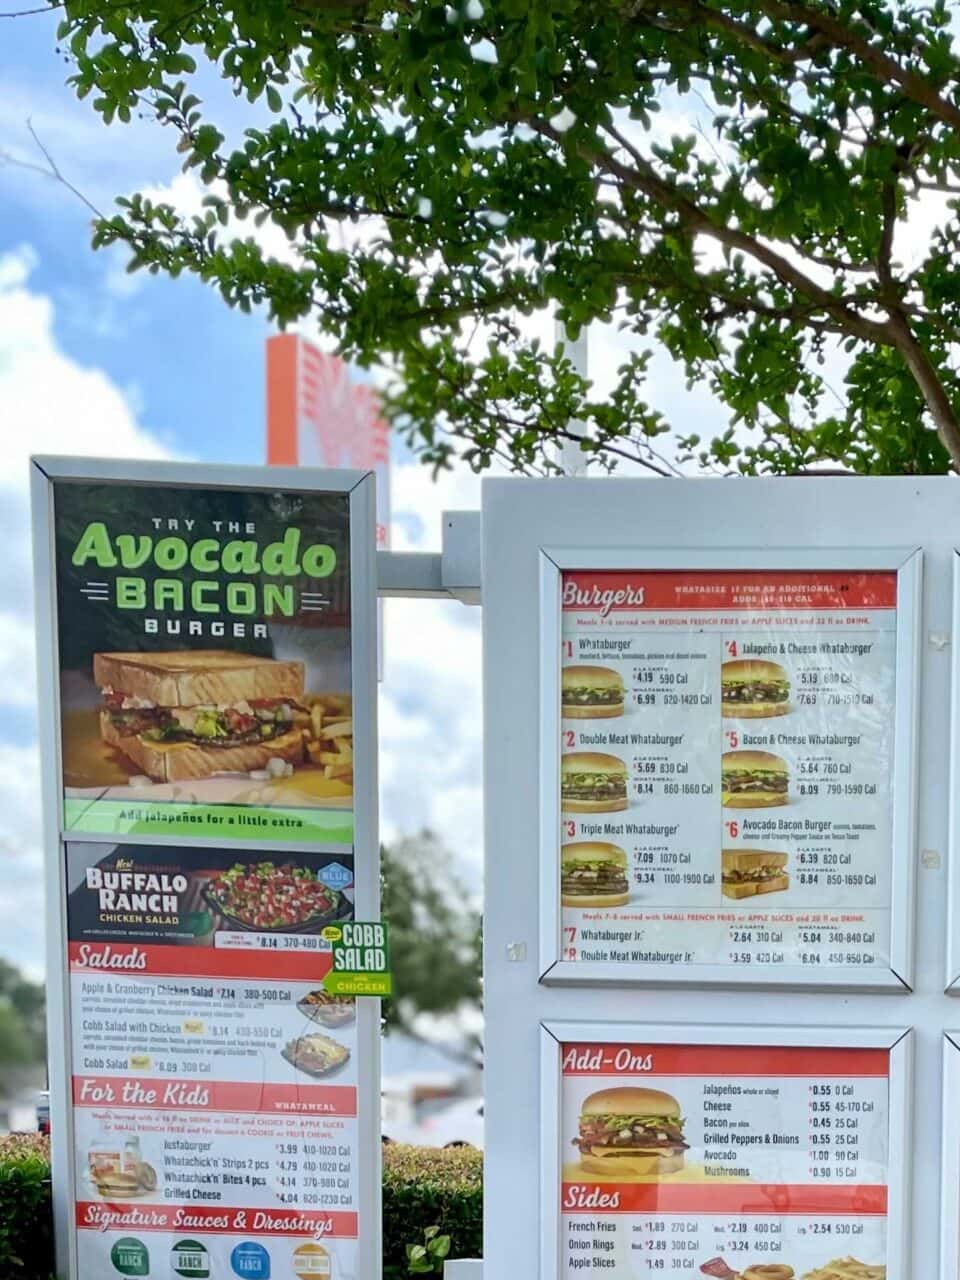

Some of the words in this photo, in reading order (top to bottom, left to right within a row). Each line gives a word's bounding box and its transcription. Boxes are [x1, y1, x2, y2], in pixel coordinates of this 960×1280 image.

[152, 518, 195, 530] TRY
[213, 521, 256, 533] THE
[72, 522, 337, 577] Avocado
[116, 577, 294, 616] BACON
[562, 582, 644, 617] Burgers
[145, 619, 268, 638] BURGER
[580, 733, 606, 744] Double
[609, 734, 629, 745] Meat
[743, 734, 767, 745] Bacon
[778, 734, 806, 744] Cheese
[238, 814, 268, 826] little
[743, 820, 774, 831] Avocado
[777, 820, 802, 831] Bacon
[805, 820, 831, 832] Burger
[580, 824, 601, 835] Triple
[604, 824, 624, 834] Meat
[86, 867, 188, 893] BUFFALO
[99, 893, 177, 913] RANCH
[100, 913, 142, 923] CHICKEN
[146, 915, 179, 925] SALAD
[343, 925, 384, 946] COBB
[76, 945, 147, 969] Salads
[335, 948, 386, 970] SALAD
[192, 986, 213, 997] Salad
[337, 982, 386, 992] CHICKEN
[104, 1021, 127, 1031] Salad
[563, 1049, 652, 1072] Add-Ons
[81, 1080, 115, 1101] For
[122, 1083, 156, 1103] the
[164, 1084, 209, 1106] Kids
[704, 1084, 742, 1096] Jalapeños
[704, 1101, 732, 1112] Cheese
[704, 1117, 728, 1128] Bacon
[704, 1133, 729, 1144] Grilled
[731, 1134, 763, 1145] Peppers
[773, 1134, 799, 1144] Onions
[704, 1150, 737, 1161] Avocado
[704, 1166, 750, 1177] Mushrooms
[192, 1190, 221, 1200] Cheese
[564, 1186, 620, 1208] Sides
[84, 1205, 167, 1231] Signature
[173, 1206, 228, 1229] Sauces
[253, 1212, 333, 1239] Dressings
[568, 1221, 594, 1232] French
[597, 1222, 616, 1232] Fries
[568, 1239, 591, 1249] Onion
[593, 1239, 615, 1251] Rings
[568, 1257, 590, 1269] Apple
[593, 1257, 616, 1268] Slices
